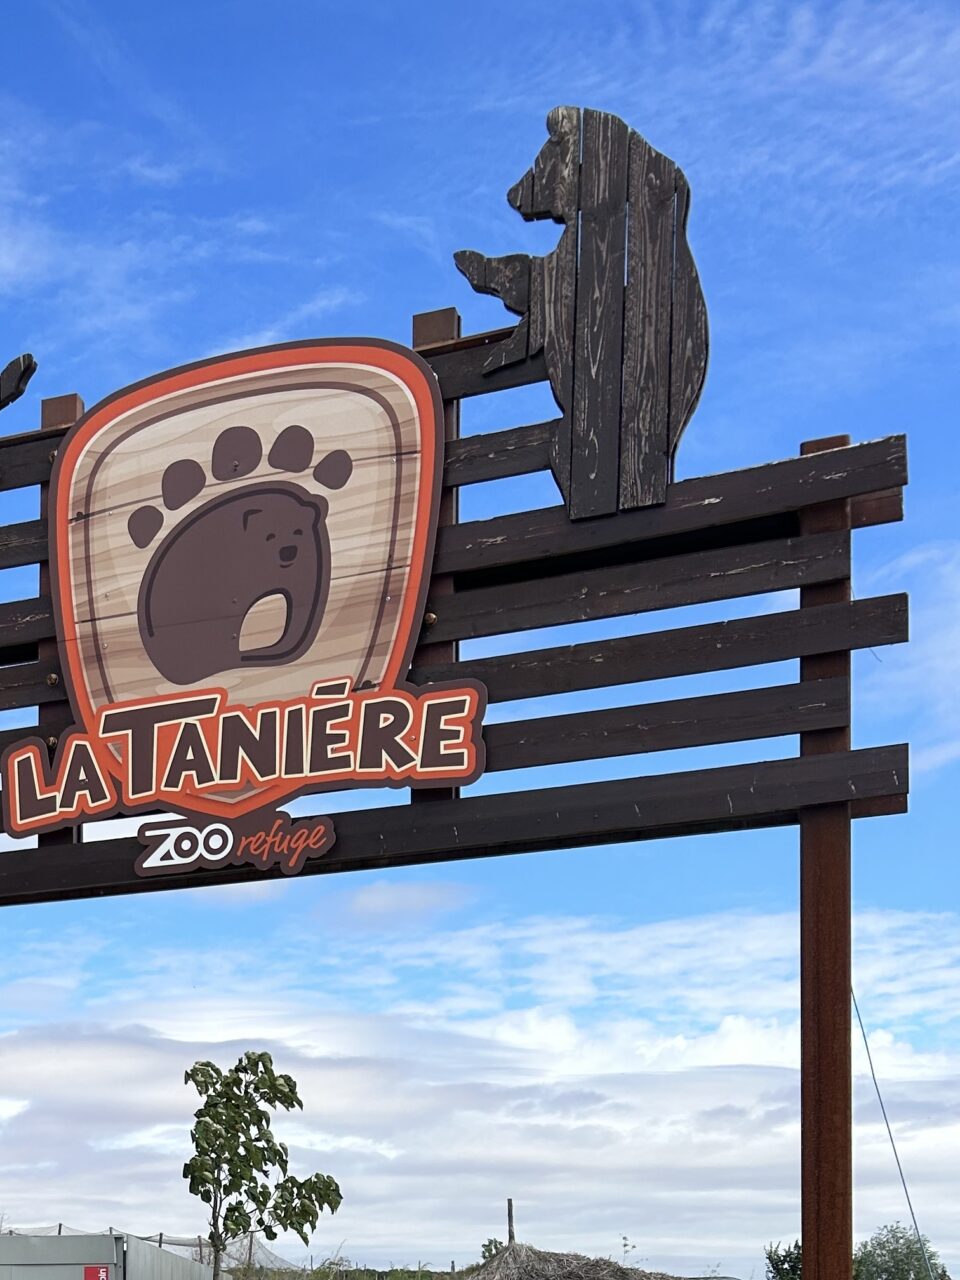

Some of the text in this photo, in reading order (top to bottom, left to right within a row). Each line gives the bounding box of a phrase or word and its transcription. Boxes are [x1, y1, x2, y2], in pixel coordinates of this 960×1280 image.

[14, 740, 111, 825] LA
[142, 819, 327, 868] ZOO refuge
